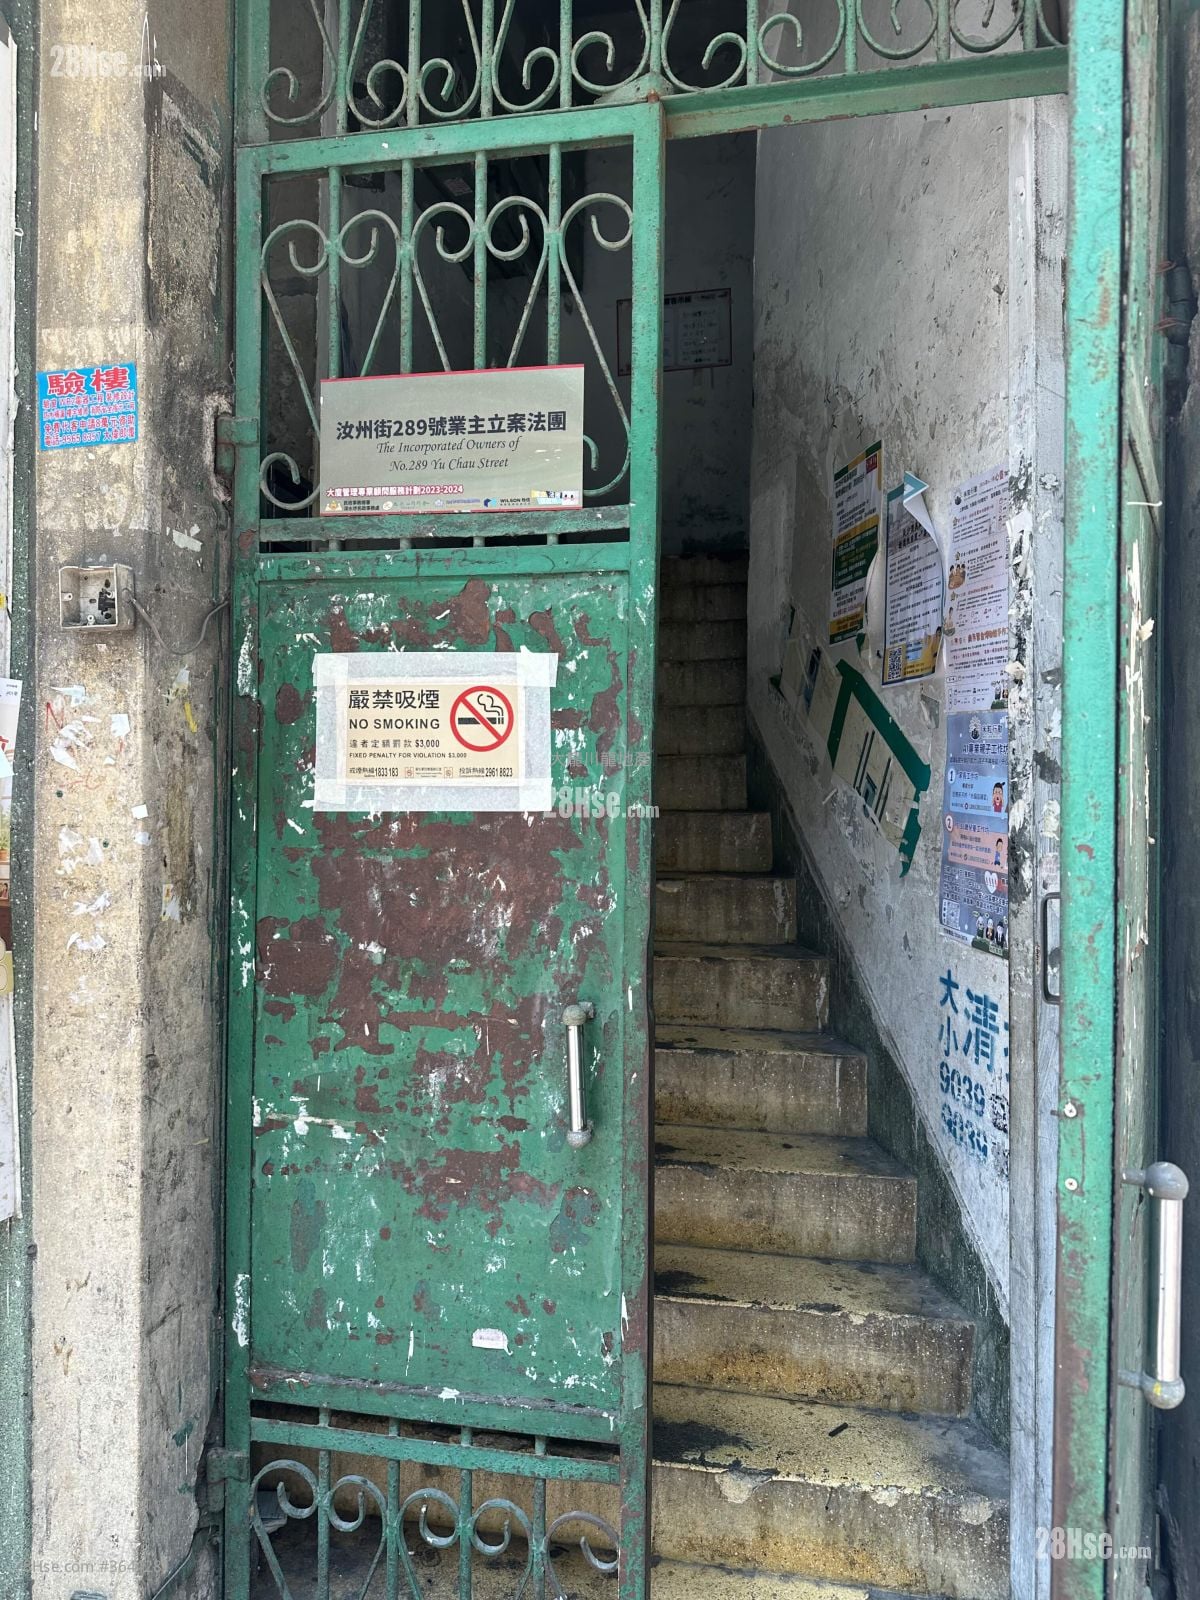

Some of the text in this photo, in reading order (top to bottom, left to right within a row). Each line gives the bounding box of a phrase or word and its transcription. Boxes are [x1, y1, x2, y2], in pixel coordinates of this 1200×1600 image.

[336, 411, 567, 440] 汝州街289號業主立案法團
[377, 436, 522, 455] The Incorporated Owners of
[389, 457, 509, 471] No.289 Yu Chau Street
[349, 689, 440, 709] 嚴禁吸煙
[349, 718, 440, 730] NO SMOKING
[415, 739, 440, 749] $3,000
[375, 767, 388, 777] 1833
[389, 767, 399, 777] 183
[485, 767, 498, 777] 2961
[499, 767, 513, 777] 8823
[939, 1060, 986, 1117] 9039
